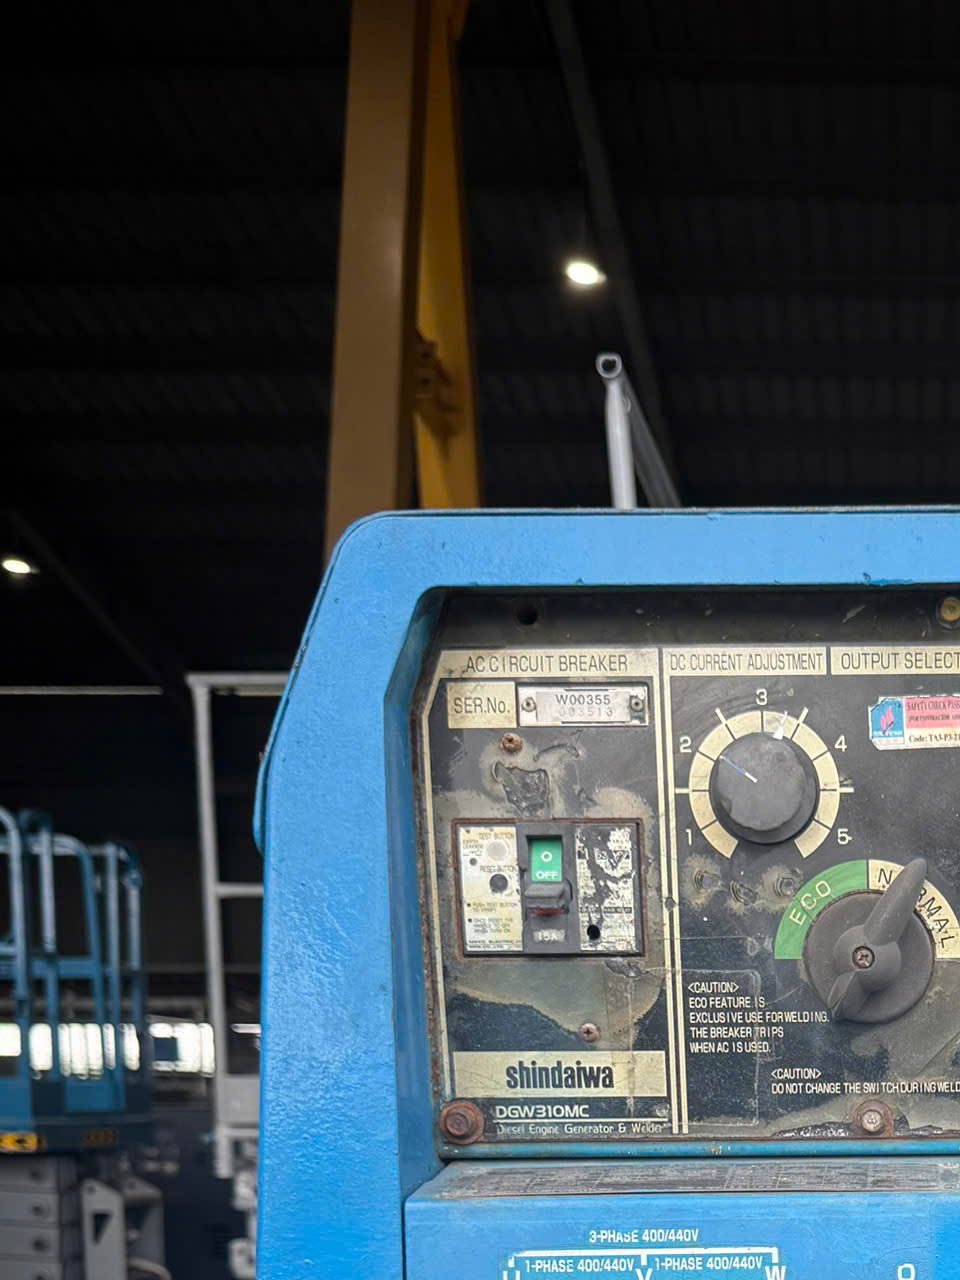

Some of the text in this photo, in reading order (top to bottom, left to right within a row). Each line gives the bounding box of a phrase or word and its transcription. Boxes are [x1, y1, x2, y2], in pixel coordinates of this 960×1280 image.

[466, 654, 628, 673] AC CIRCUIT BREAKER
[670, 652, 823, 671] DC CURRENT ADJUSTMENT
[841, 652, 898, 670] OUTPUT
[556, 694, 611, 705] W00355
[756, 688, 768, 705] 3
[454, 697, 511, 714] SER.No.
[928, 700, 946, 710] CHECK
[679, 737, 692, 753] 2
[834, 736, 848, 752] 4
[909, 734, 927, 743] Code:
[685, 828, 693, 845] 1
[837, 828, 850, 844] 5
[535, 870, 559, 880] OFF
[789, 880, 832, 926] ECO
[689, 996, 766, 1009] ECO FEATURE IS
[690, 1012, 743, 1024] EXCLUSIVE
[745, 1012, 763, 1024] USE
[690, 1027, 784, 1038] THE BREAKER TRIPS
[690, 1041, 771, 1054] WHEN AC IS USED.
[505, 1060, 615, 1089] shindaiwa
[771, 1083, 784, 1094] DO
[785, 1083, 804, 1094] NOT
[805, 1082, 840, 1094] CHANGE
[844, 1082, 862, 1093] THE
[863, 1082, 898, 1093] SWITCH
[495, 1104, 589, 1118] DGW310MC
[497, 1122, 664, 1136] Diesel Engine Generator & Welder
[589, 1228, 699, 1244] 3-PHASE 400/440V
[525, 1258, 635, 1273] 1-PHASE 400/440V
[654, 1256, 763, 1271] 1-PHASE 400/440V
